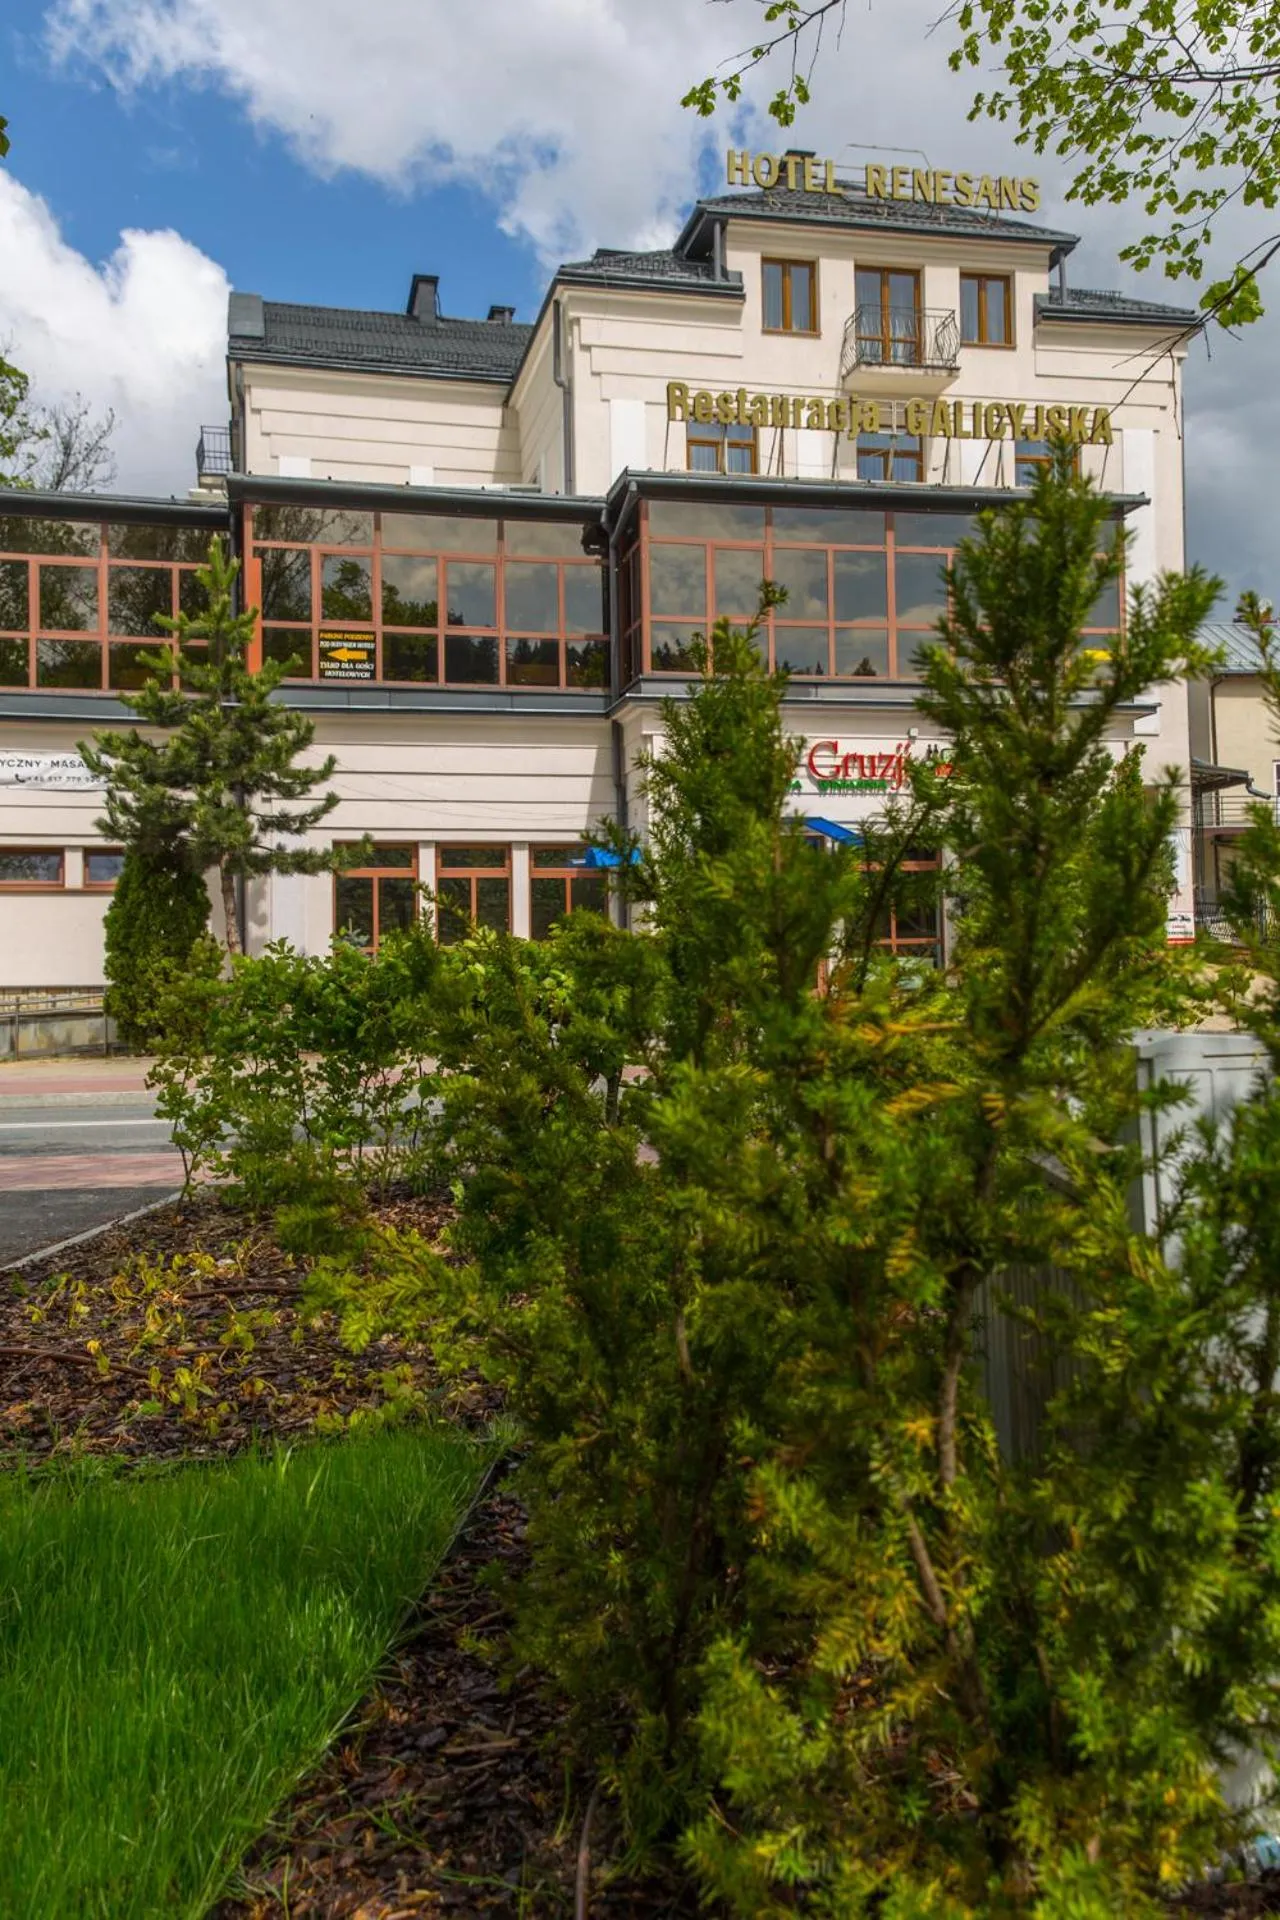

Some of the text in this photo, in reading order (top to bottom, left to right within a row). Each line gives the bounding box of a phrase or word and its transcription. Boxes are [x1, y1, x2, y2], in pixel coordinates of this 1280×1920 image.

[727, 149, 1041, 213] HOTEL RENESANS
[666, 381, 1113, 446] Restauracja GALICYJSKA
[320, 661, 340, 669] TYLKO
[341, 661, 354, 669] DLA
[324, 670, 371, 678] HOTELOWYCH
[50, 759, 88, 769] MASA
